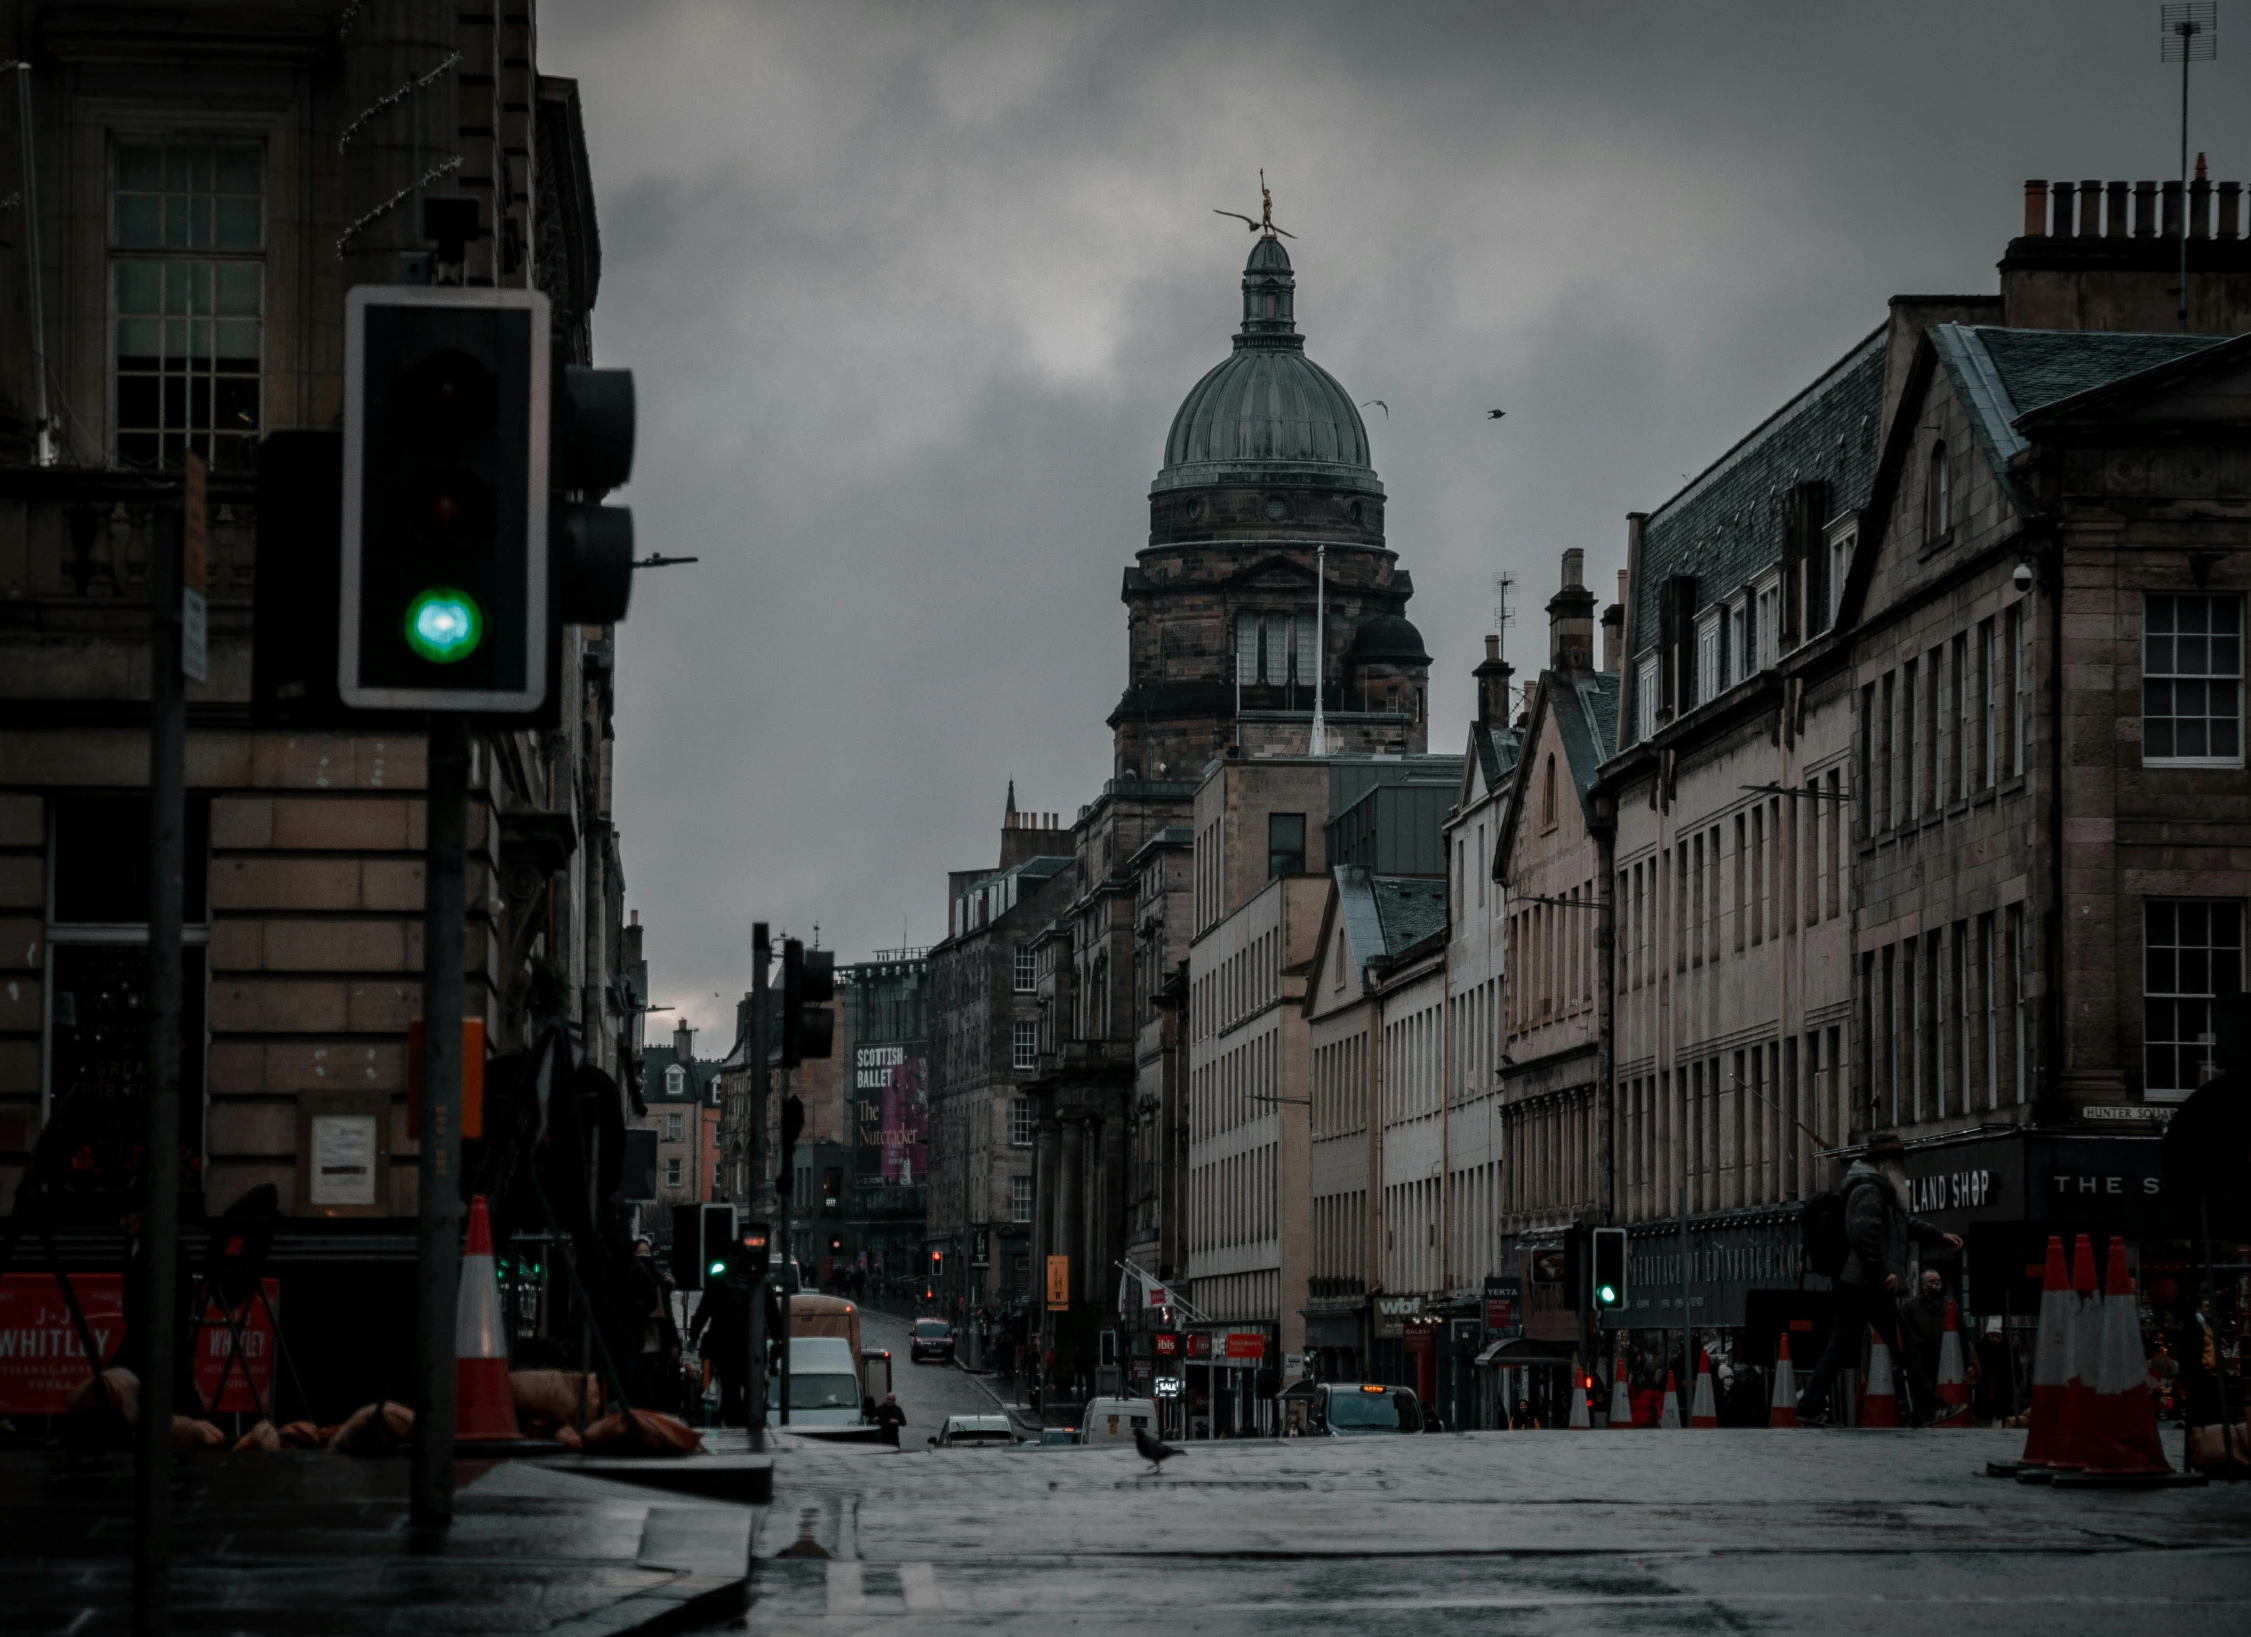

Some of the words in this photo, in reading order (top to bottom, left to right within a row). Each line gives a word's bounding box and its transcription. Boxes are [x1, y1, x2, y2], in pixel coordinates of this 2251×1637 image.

[857, 1047, 904, 1067] SCOTTISH
[96, 1060, 146, 1076] GREA
[857, 1069, 892, 1088] BALLET
[858, 1099, 880, 1121] The
[2087, 1107, 2132, 1118] HUNTER
[859, 1122, 918, 1147] Nutcracker
[1952, 1169, 1989, 1208] SHOP
[2053, 1175, 2123, 1194] THE
[2142, 1176, 2161, 1195] S
[1632, 1254, 1681, 1286] HERITAGE
[1686, 1252, 1700, 1283] OF
[1487, 1288, 1519, 1296] YEKTA
[1380, 1297, 1421, 1315] wbf
[1158, 1339, 1176, 1350] ibis
[1160, 1382, 1178, 1391] SALE
